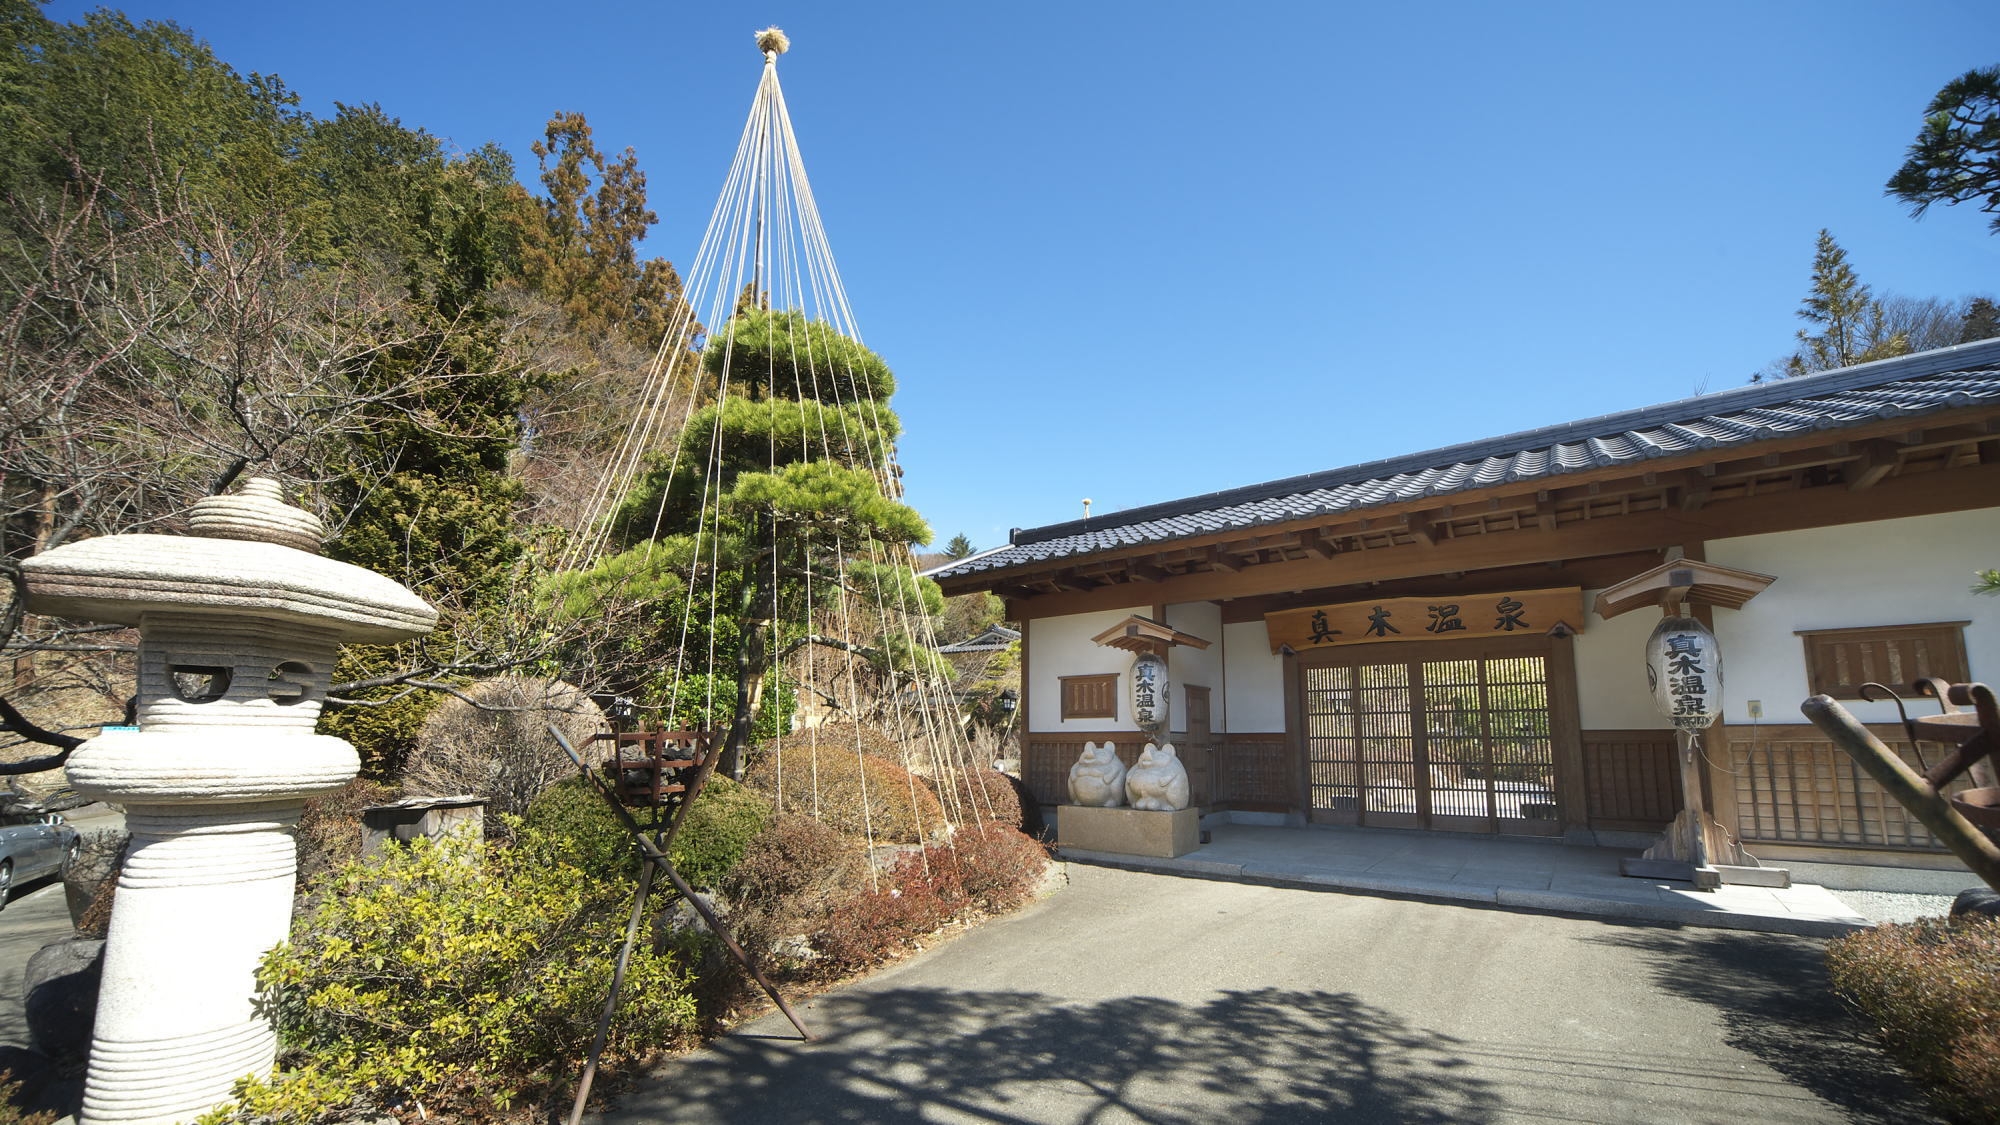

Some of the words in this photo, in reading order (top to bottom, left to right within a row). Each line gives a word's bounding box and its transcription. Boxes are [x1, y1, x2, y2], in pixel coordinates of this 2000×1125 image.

[1306, 596, 1530, 645] 真木温泉
[1135, 664, 1156, 723] 真木温泉
[1664, 634, 1708, 716] 真木温泉
